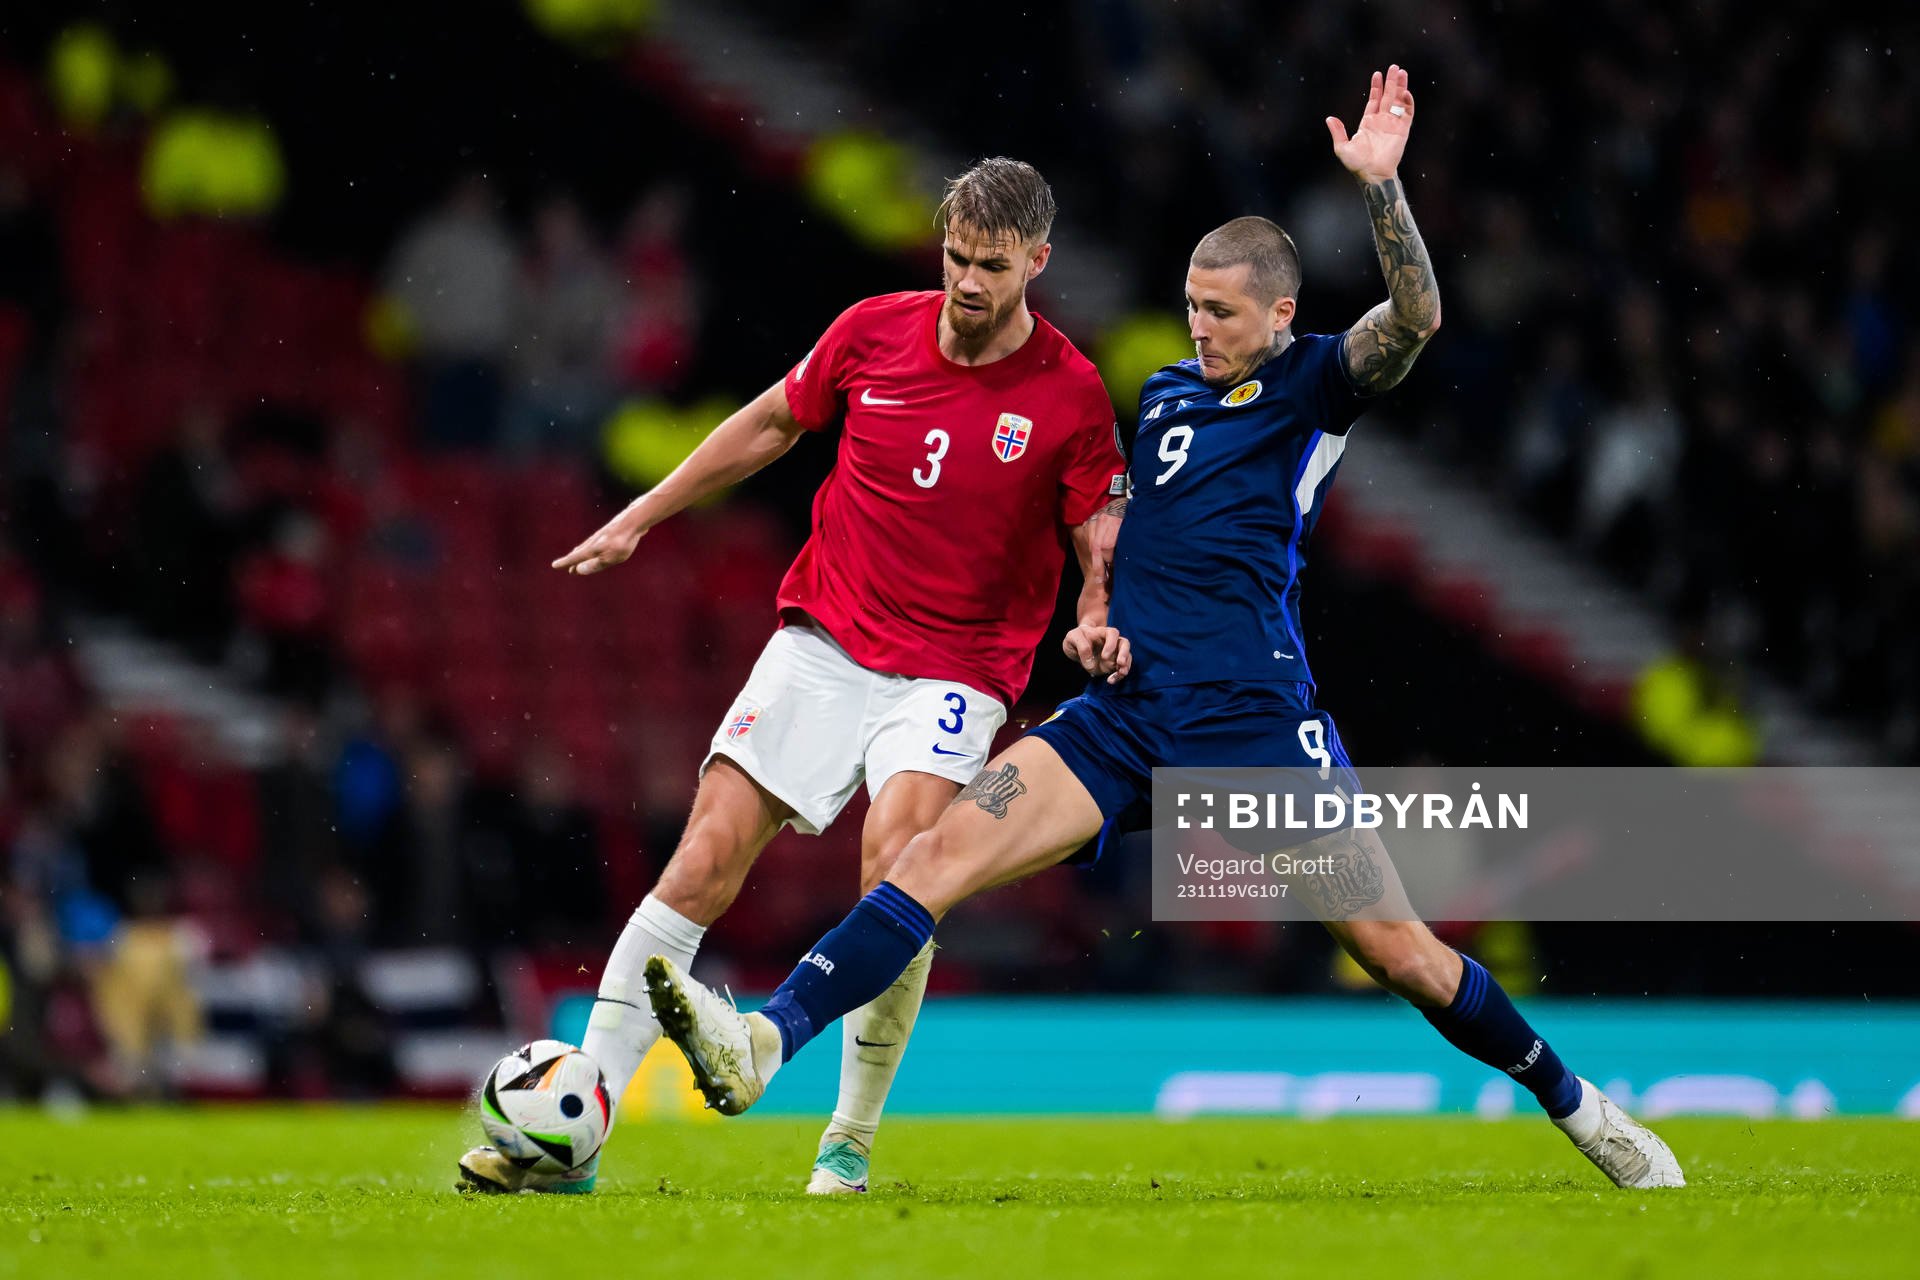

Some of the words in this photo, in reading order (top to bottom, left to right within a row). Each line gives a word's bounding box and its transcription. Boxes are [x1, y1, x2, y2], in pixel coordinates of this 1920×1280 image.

[912, 428, 950, 489] 3
[1155, 425, 1195, 486] 9
[938, 692, 967, 735] 3
[1297, 719, 1332, 780] 9
